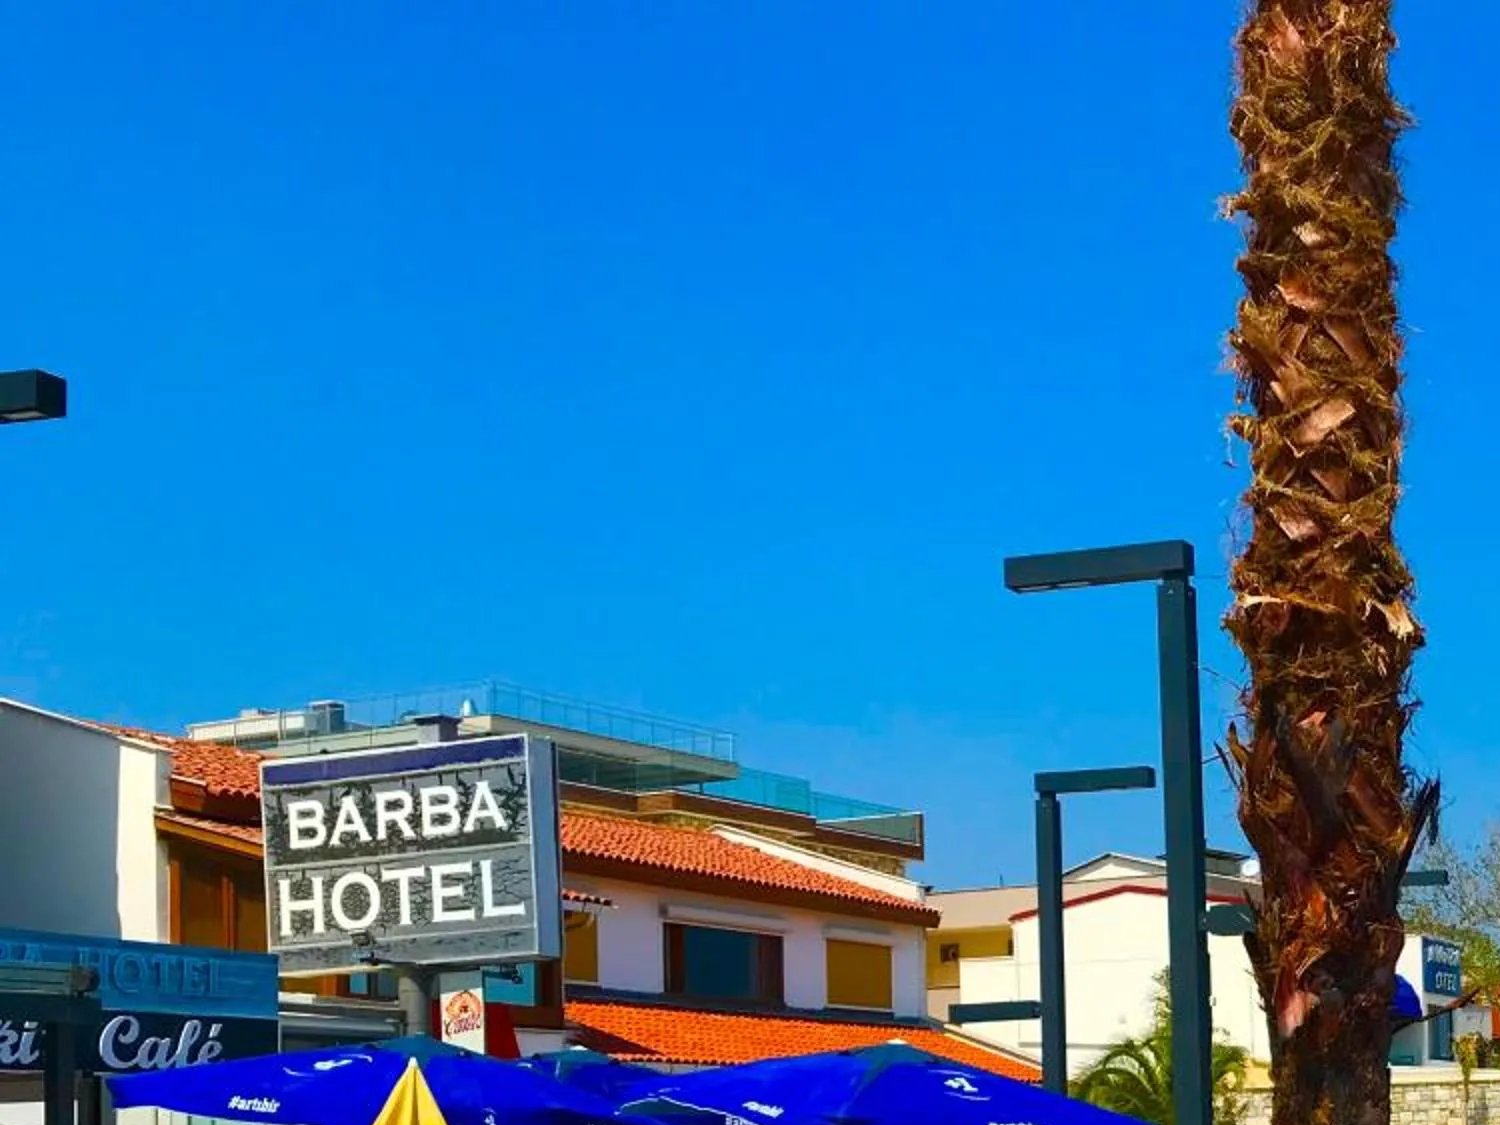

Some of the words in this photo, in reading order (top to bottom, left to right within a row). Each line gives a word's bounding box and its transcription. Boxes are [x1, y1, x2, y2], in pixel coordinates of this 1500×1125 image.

[287, 780, 508, 850] BARBA
[277, 859, 526, 937] HOTEL
[98, 1014, 224, 1070] Café
